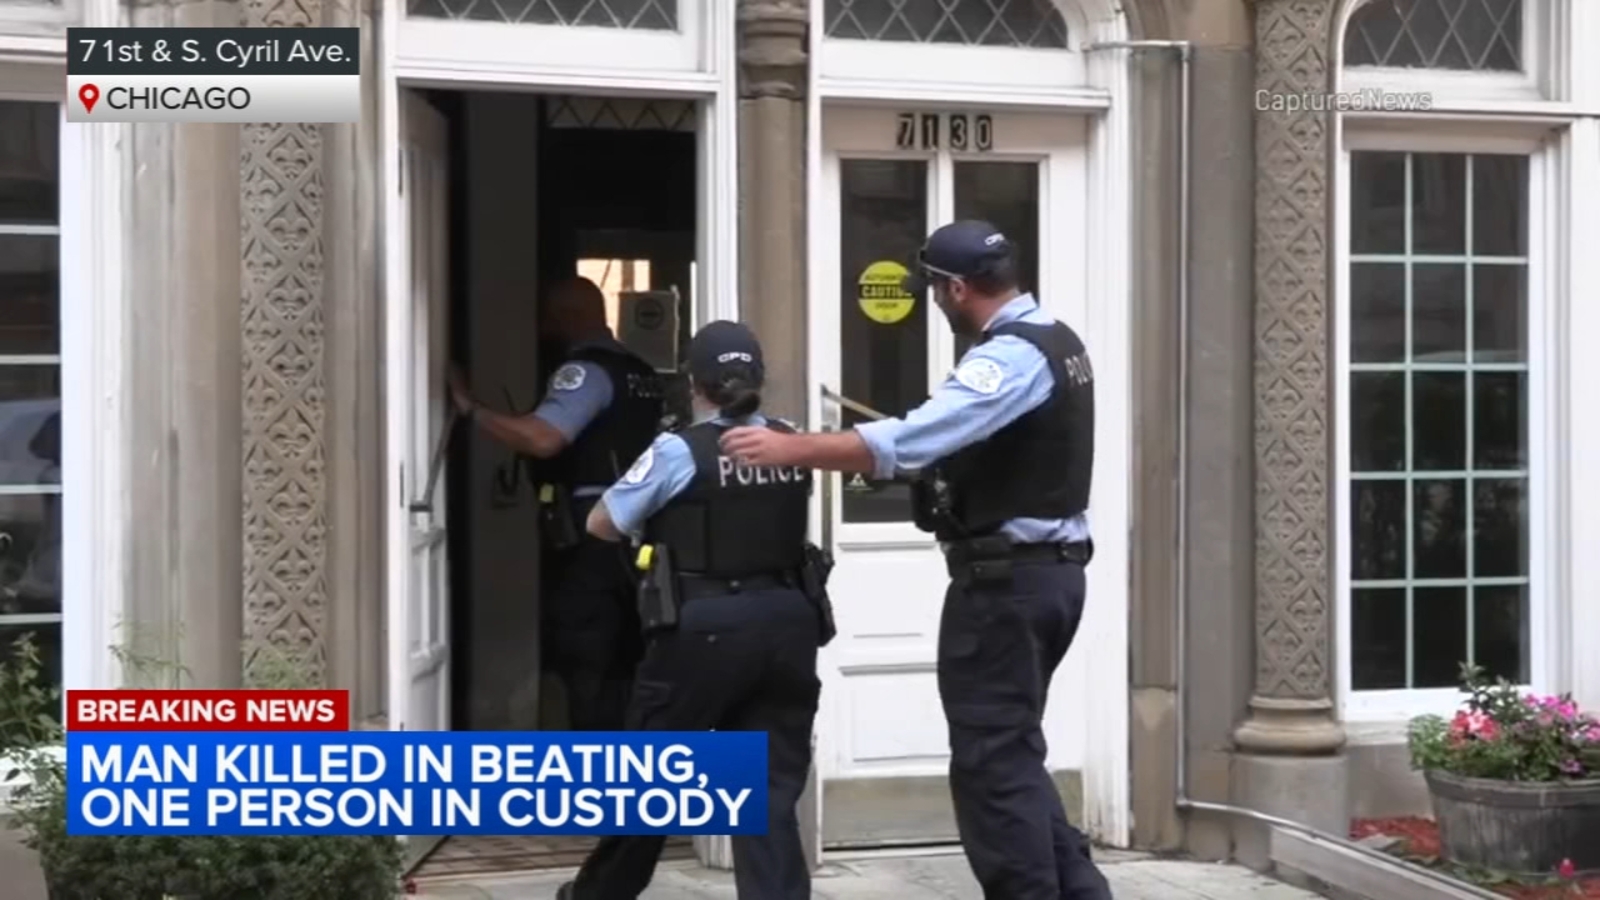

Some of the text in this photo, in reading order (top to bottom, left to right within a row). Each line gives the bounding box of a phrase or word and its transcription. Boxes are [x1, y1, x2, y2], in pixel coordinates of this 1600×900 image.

[897, 113, 992, 150] 7130
[861, 284, 913, 297] CAUTI
[718, 455, 804, 488] POLICE
